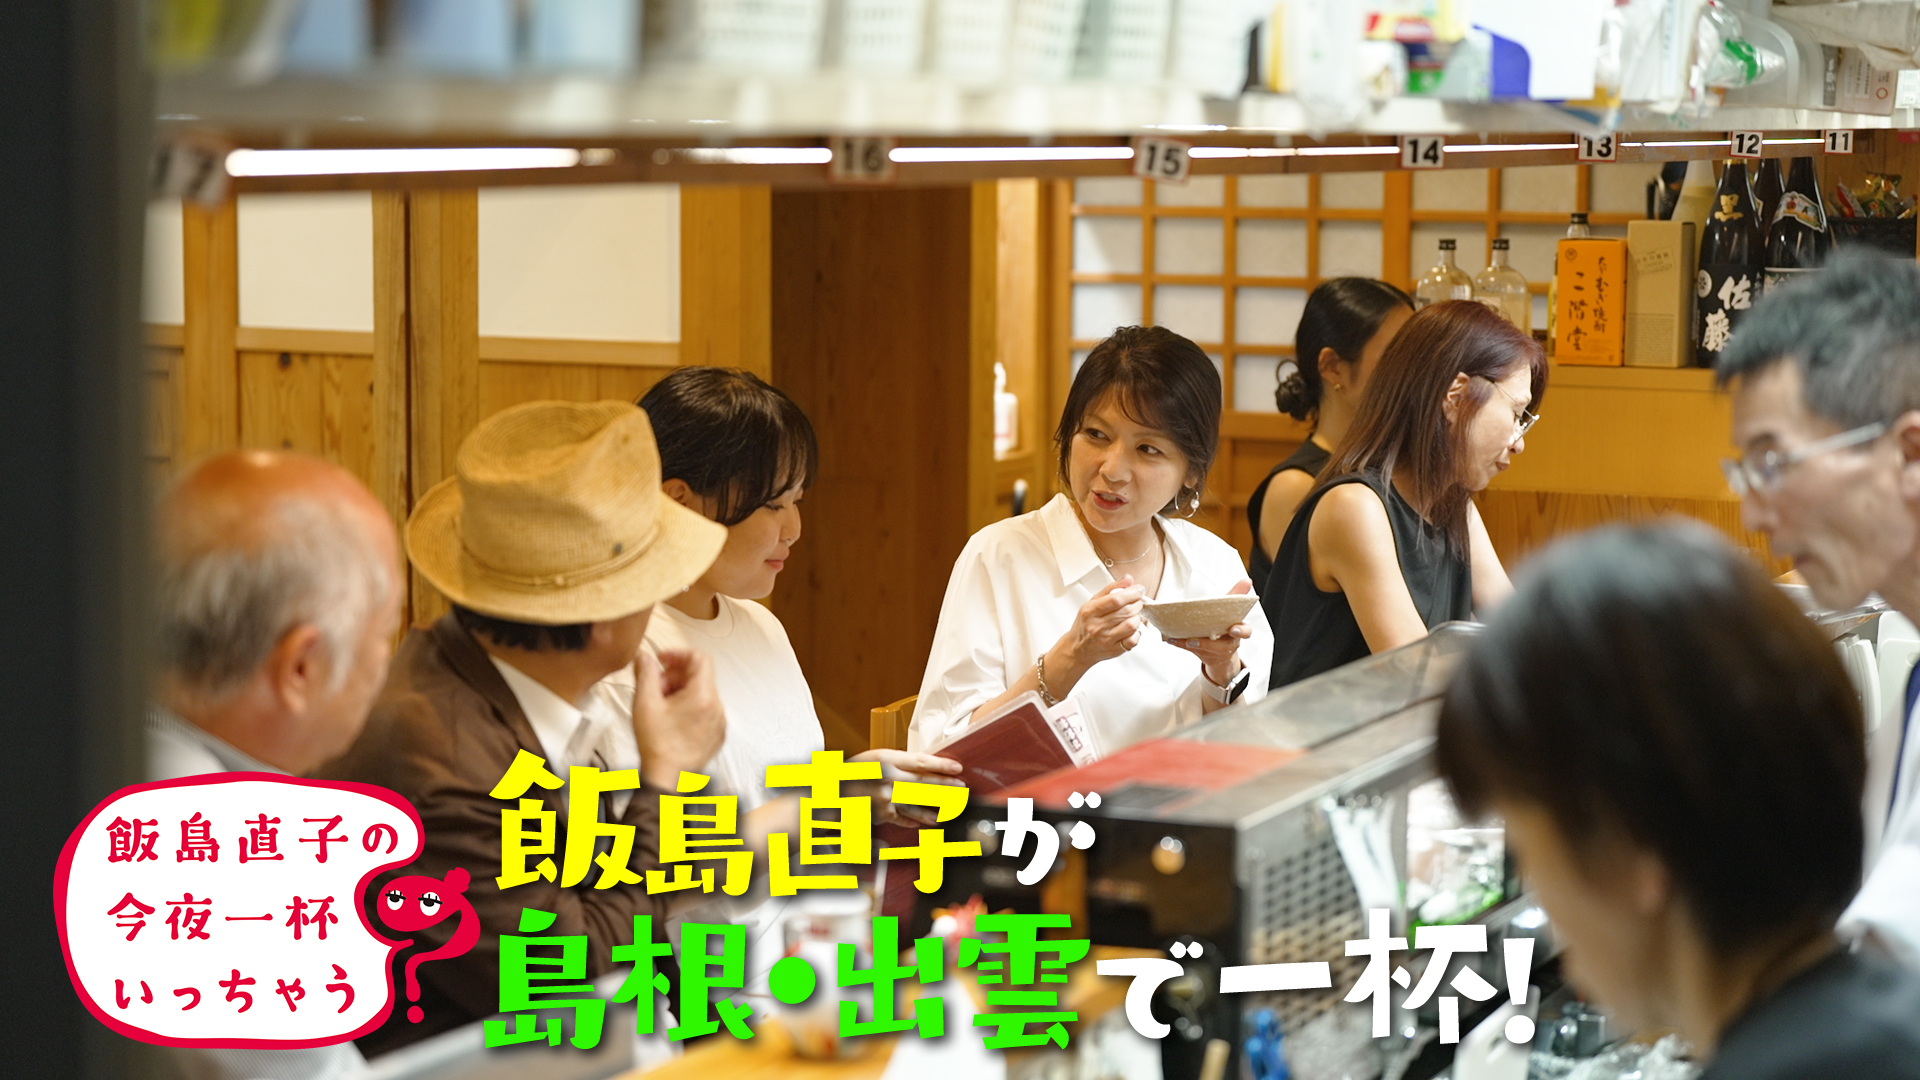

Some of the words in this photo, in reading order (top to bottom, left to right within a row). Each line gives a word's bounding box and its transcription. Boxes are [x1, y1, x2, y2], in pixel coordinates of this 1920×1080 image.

[1408, 138, 1440, 165] 14
[1583, 135, 1613, 158] 13
[1736, 133, 1760, 154] 12
[1829, 132, 1850, 151] 11
[842, 140, 885, 173] 16
[1146, 144, 1182, 176] 15
[1567, 271, 1589, 351] 二階堂
[1702, 273, 1752, 352] 佐藤
